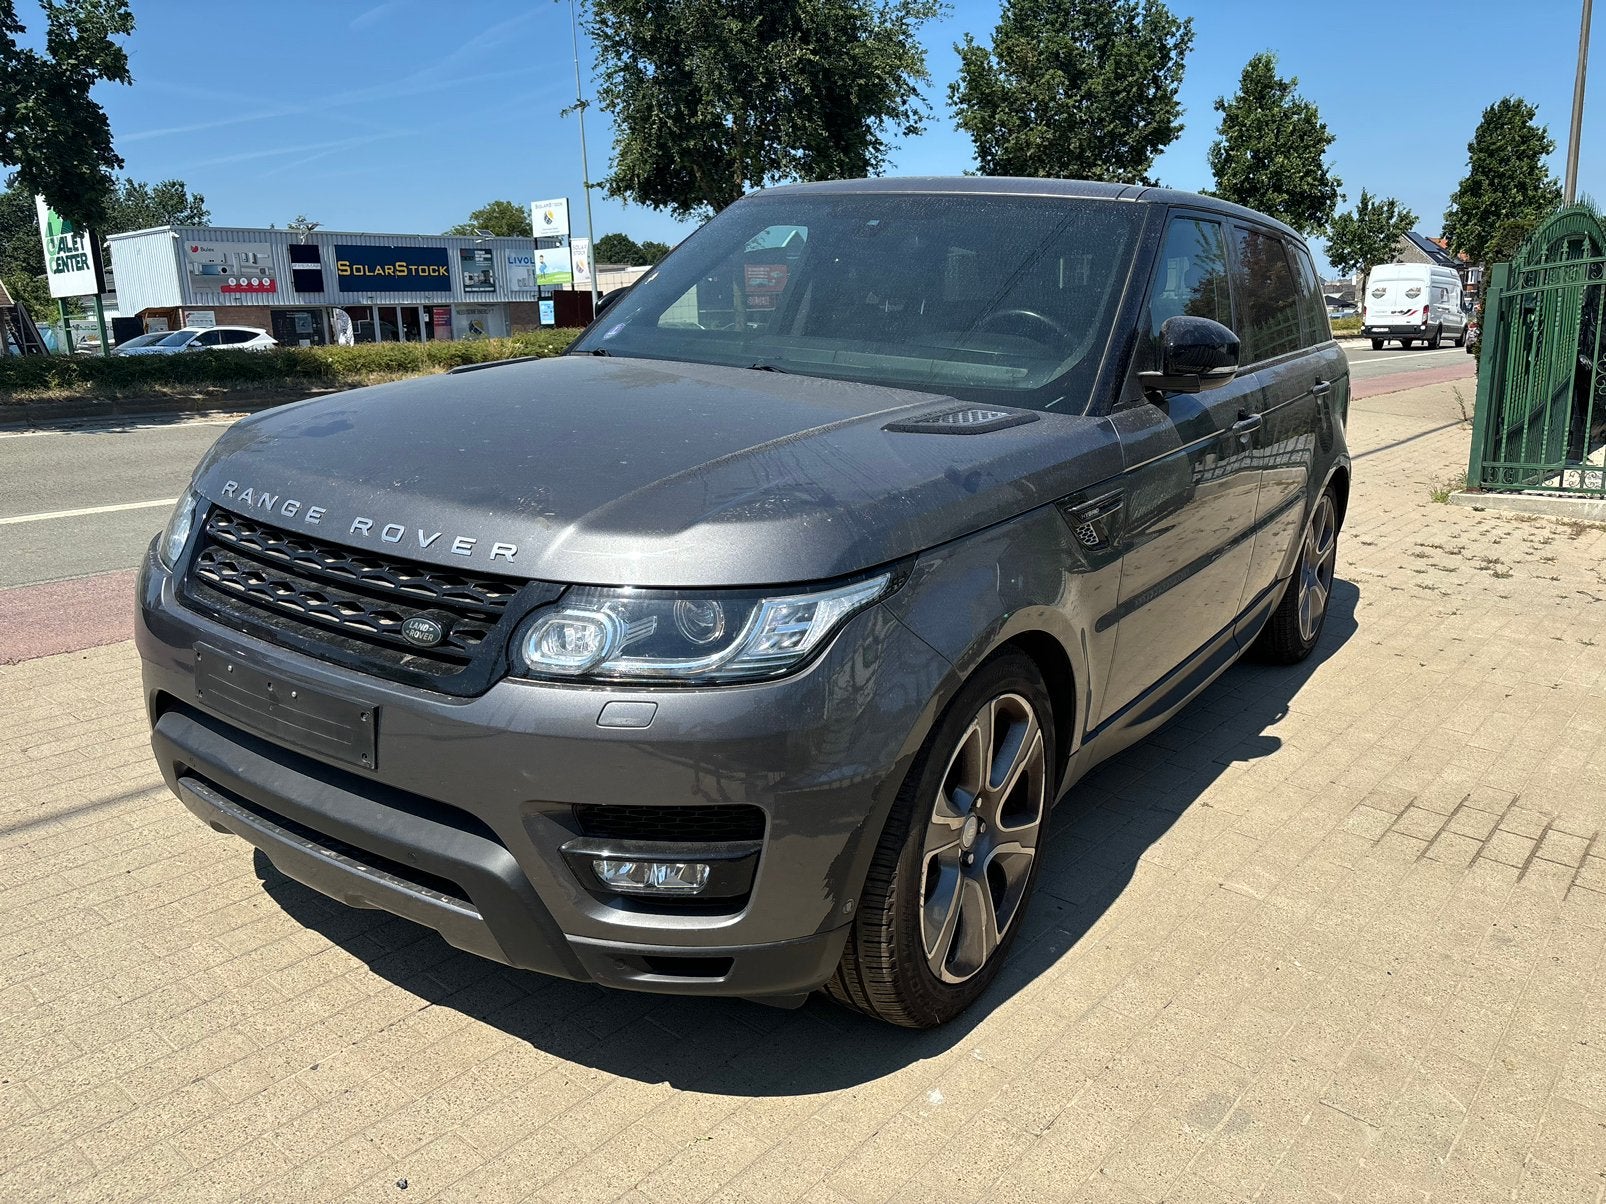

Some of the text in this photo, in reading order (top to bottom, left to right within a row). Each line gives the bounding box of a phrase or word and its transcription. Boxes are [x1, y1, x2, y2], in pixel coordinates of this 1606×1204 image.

[49, 253, 90, 274] CENTER
[221, 479, 519, 564] RANGE ROVER
[409, 628, 435, 642] ROVER
